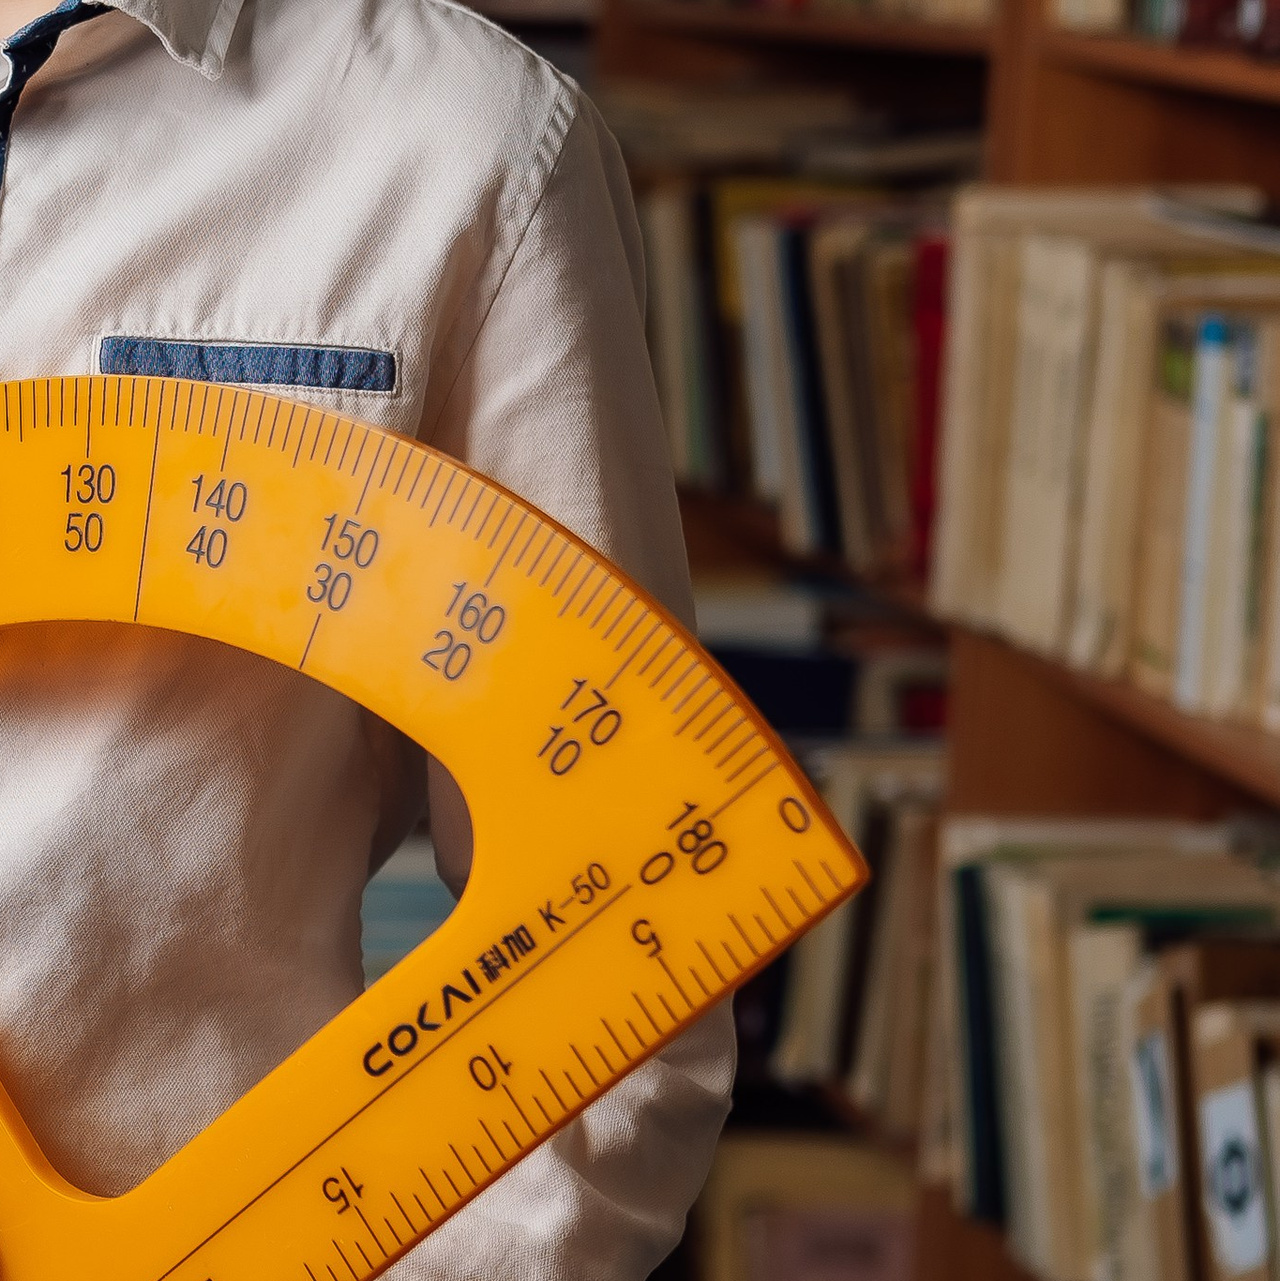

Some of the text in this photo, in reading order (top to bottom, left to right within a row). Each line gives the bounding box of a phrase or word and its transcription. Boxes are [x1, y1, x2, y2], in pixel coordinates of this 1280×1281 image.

[61, 463, 117, 505] 130
[192, 474, 248, 523] 140
[64, 512, 103, 553] 50
[187, 527, 228, 570] 40
[320, 514, 379, 569] 150
[306, 563, 351, 612] 30
[445, 581, 506, 644] 160
[422, 630, 472, 682] 20
[561, 679, 623, 746] 170
[537, 726, 583, 776] 10
[666, 802, 728, 875] 180
[779, 797, 811, 834] 0
[640, 851, 675, 885] 0
[631, 919, 661, 958] 5
[362, 968, 482, 1078] COKAI
[538, 863, 611, 933] K-50
[468, 1045, 512, 1091] 10
[322, 1167, 364, 1215] 15
